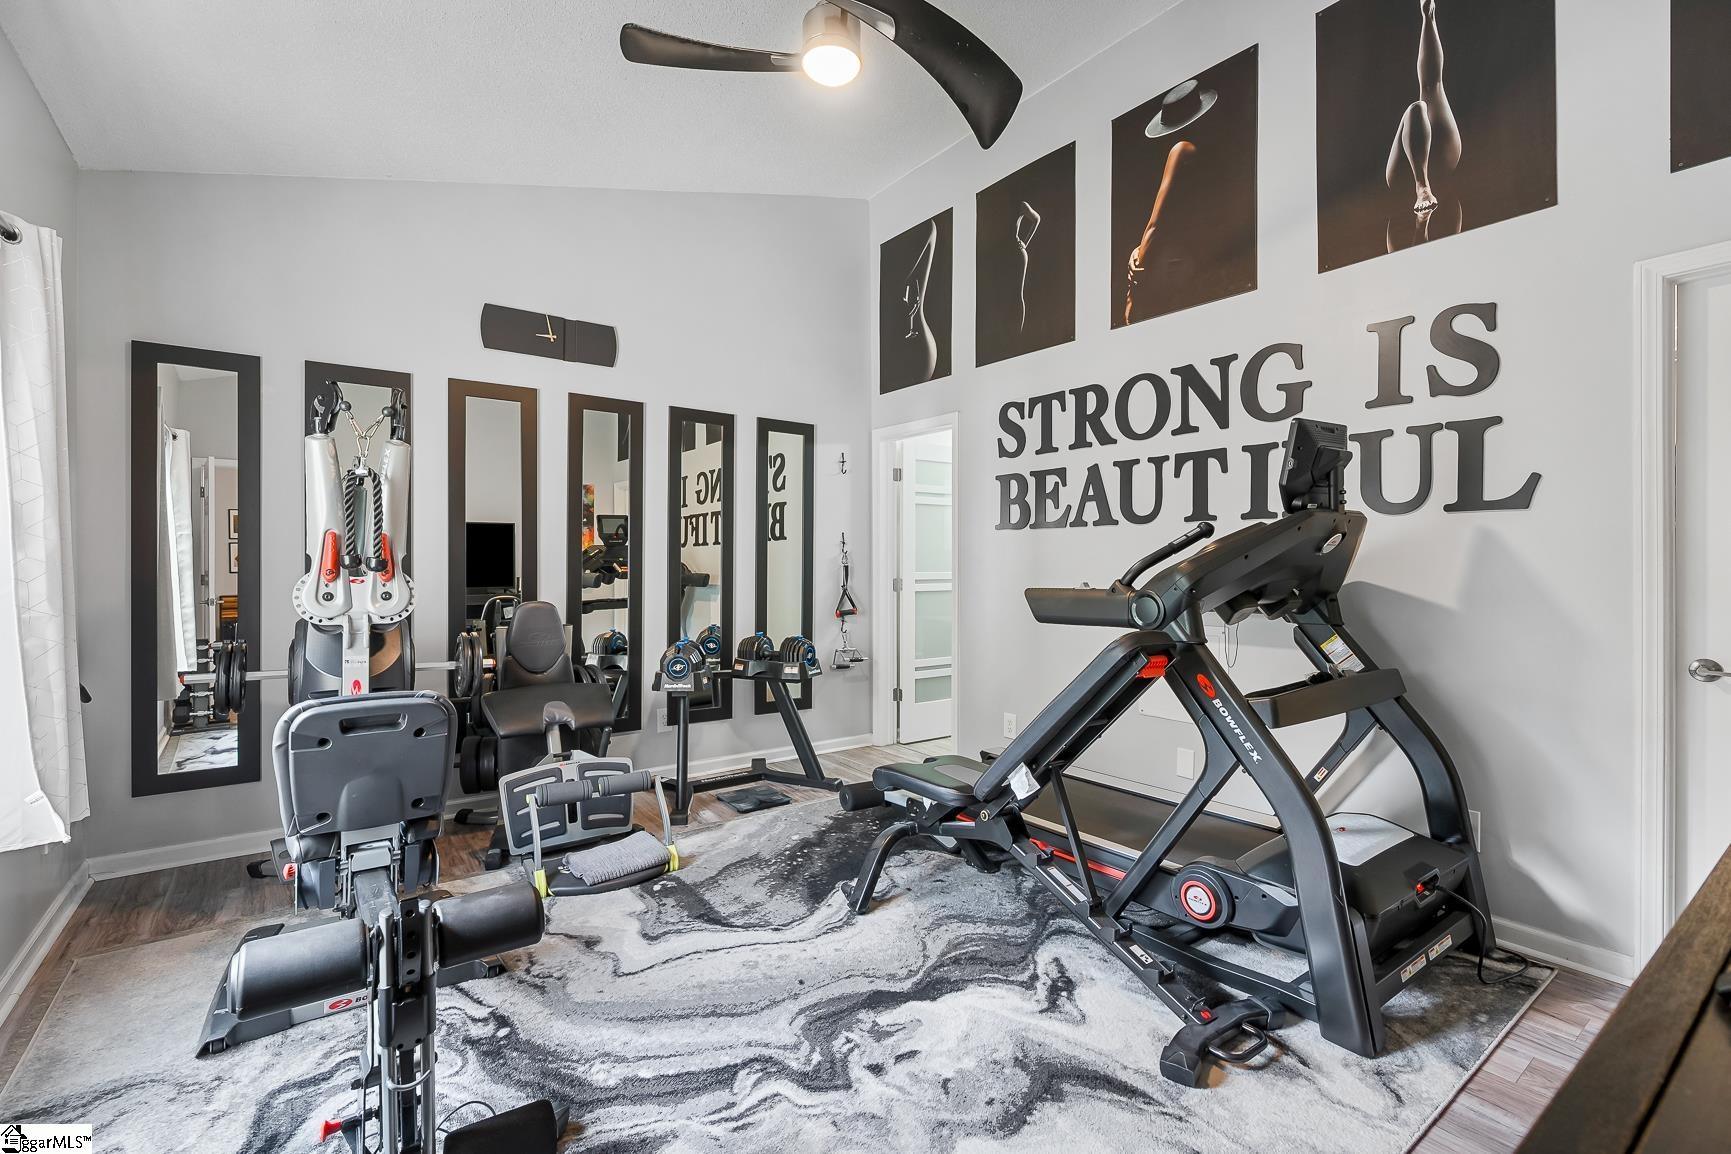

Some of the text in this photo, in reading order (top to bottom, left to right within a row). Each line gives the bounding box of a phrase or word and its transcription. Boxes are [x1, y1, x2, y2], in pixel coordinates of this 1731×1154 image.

[997, 302, 1501, 458] STRONG IS
[995, 415, 1542, 530] BEAUTIUL
[1212, 698, 1262, 763] BOWFLEX
